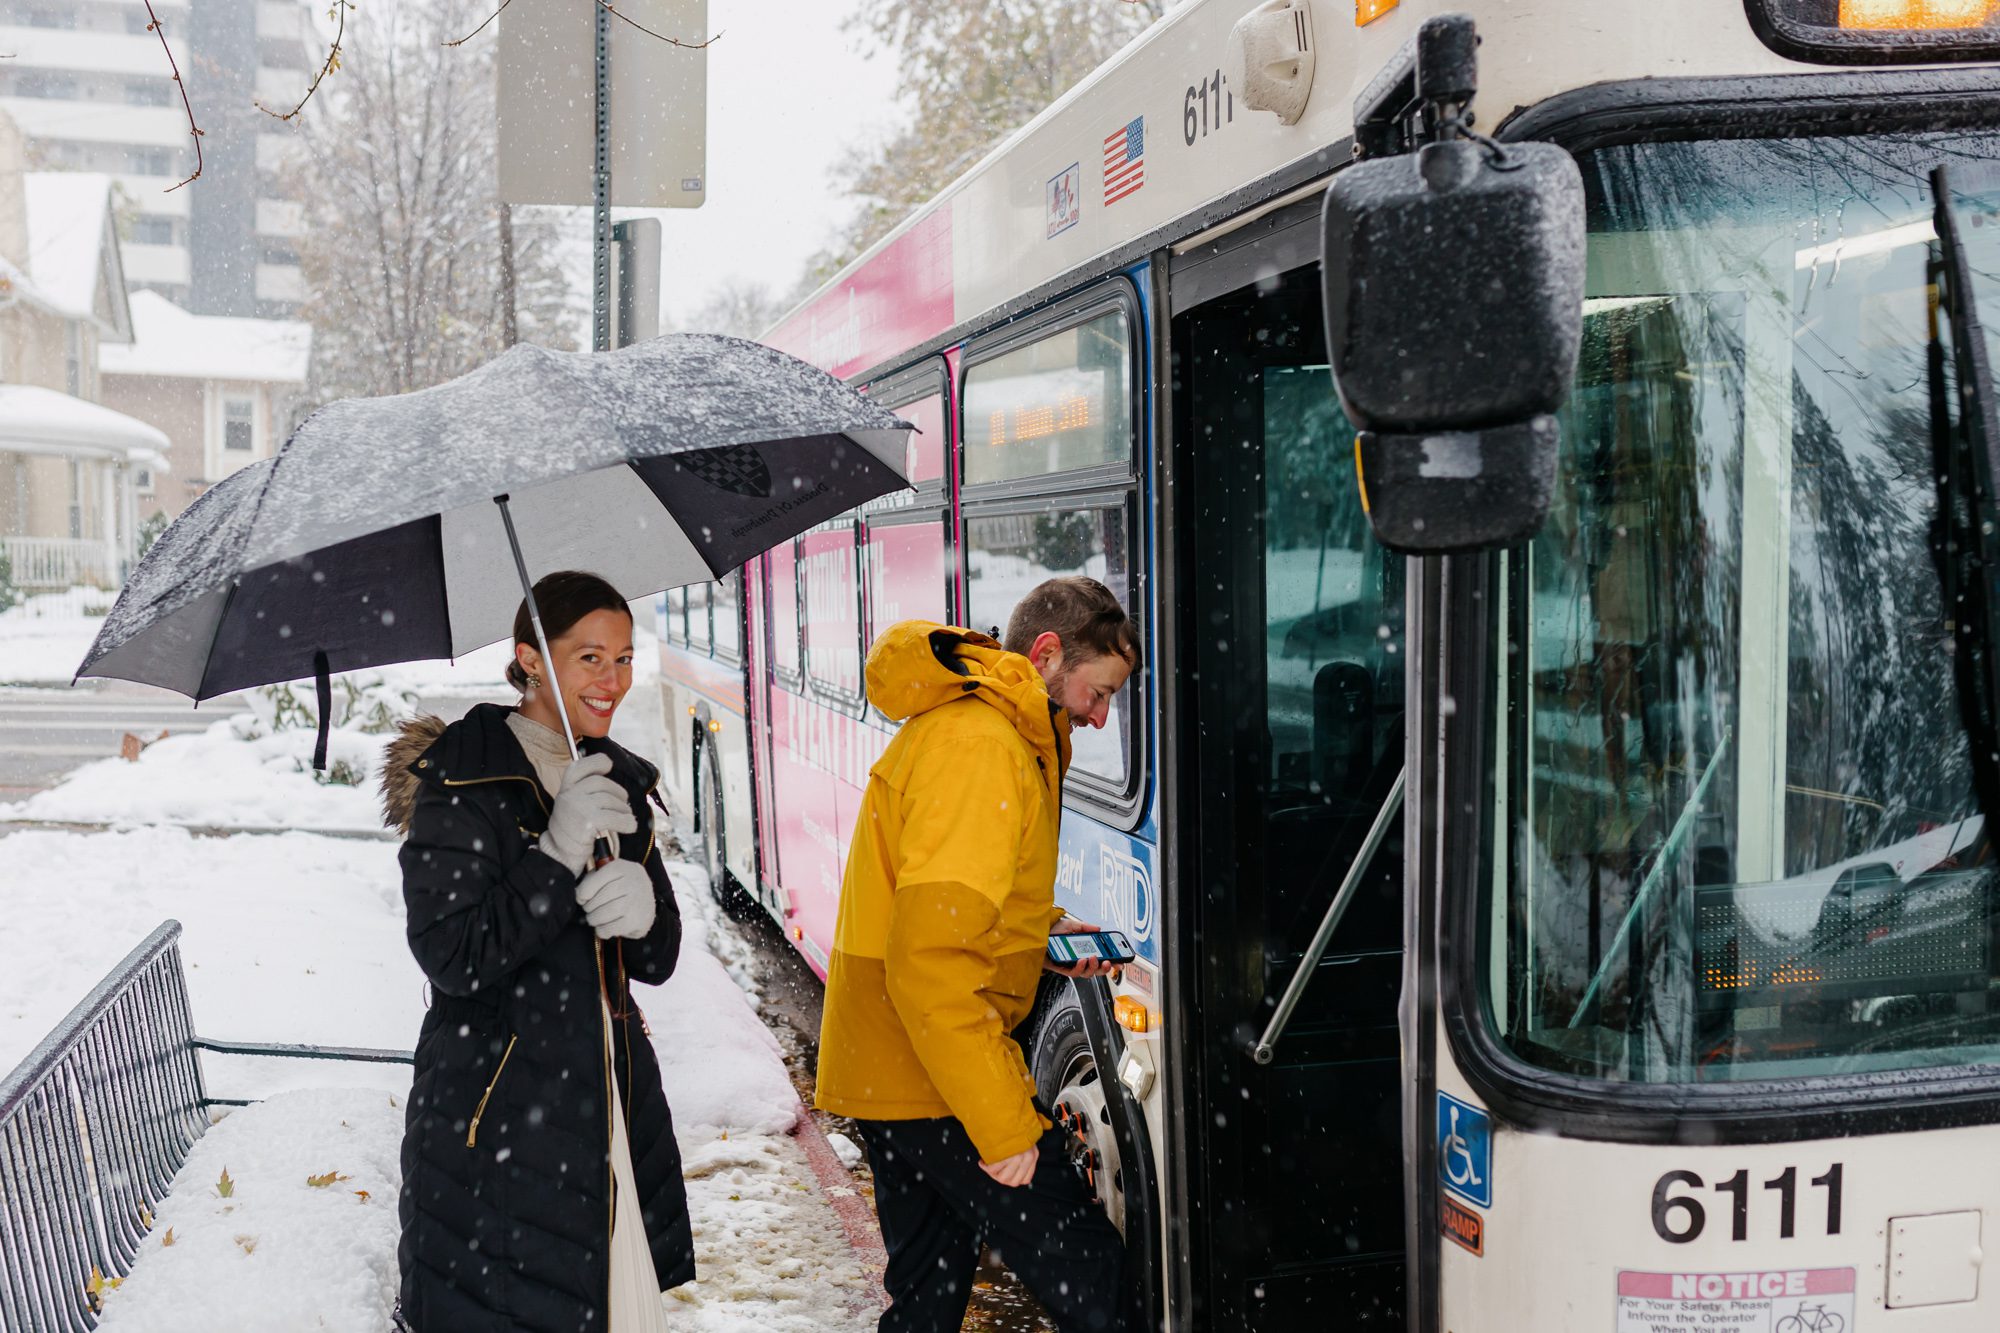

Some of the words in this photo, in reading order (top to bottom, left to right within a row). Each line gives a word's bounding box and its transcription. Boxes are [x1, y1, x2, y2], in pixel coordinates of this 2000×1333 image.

[1100, 843, 1153, 942] RTD
[1651, 1162, 1844, 1244] 6111
[1442, 1204, 1478, 1242] RAMP
[1671, 1271, 1808, 1299] NOTICE
[1619, 1298, 1640, 1309] For
[1645, 1299, 1675, 1311] Your
[1730, 1301, 1771, 1311] Please
[1627, 1310, 1670, 1322] Inform
[1676, 1312, 1696, 1323] the
[1702, 1312, 1757, 1324] Operator
